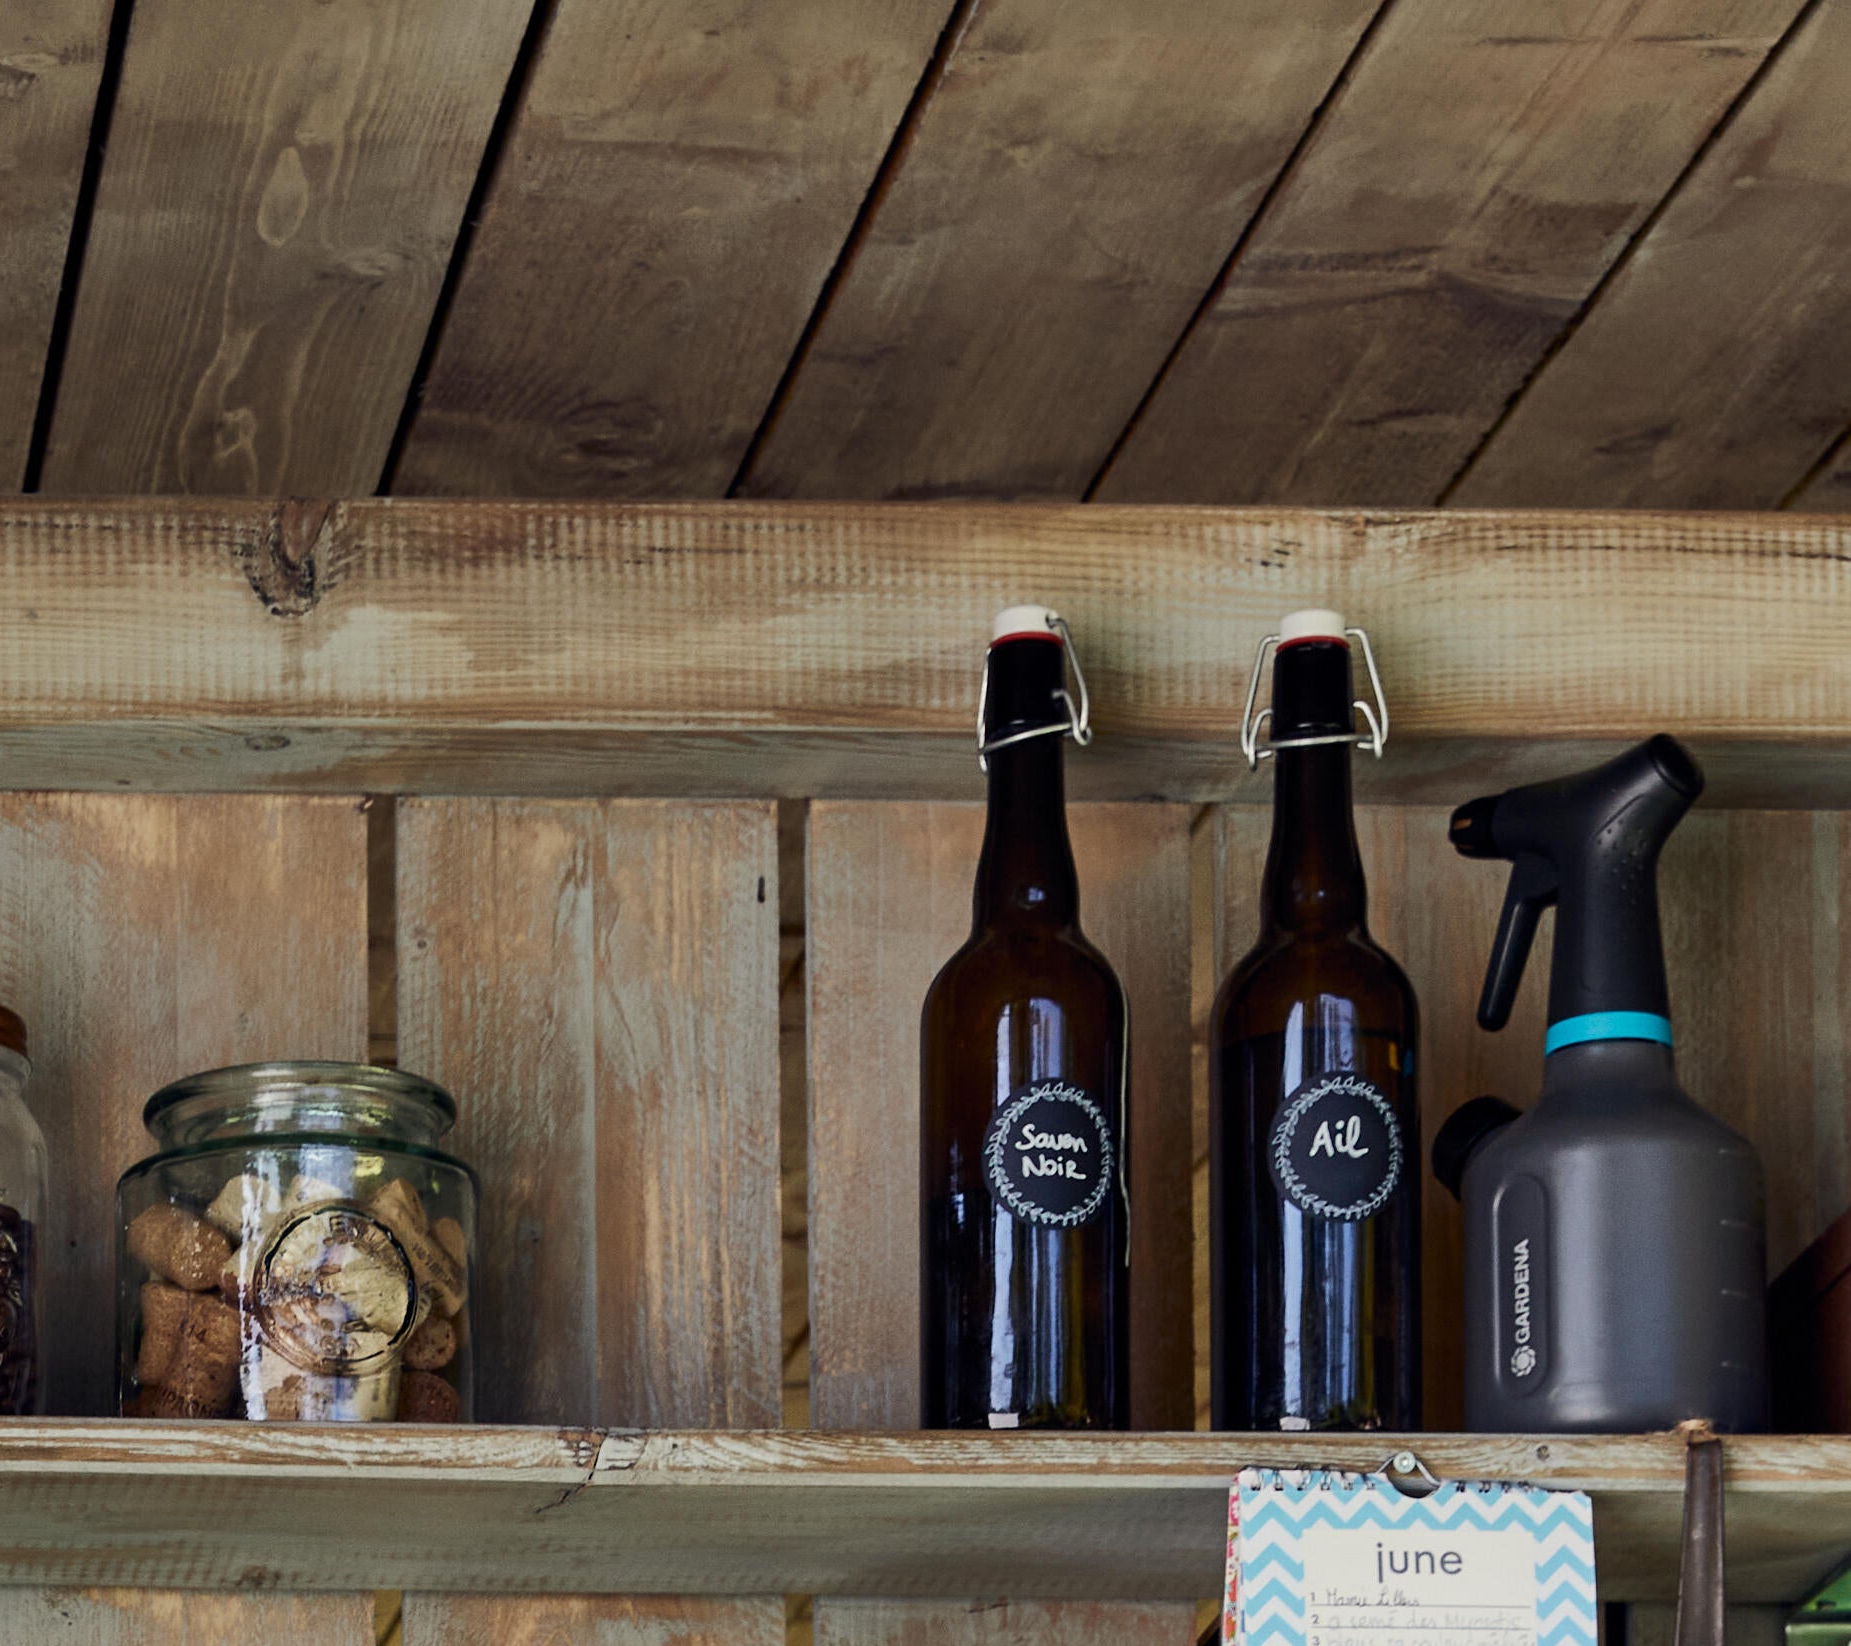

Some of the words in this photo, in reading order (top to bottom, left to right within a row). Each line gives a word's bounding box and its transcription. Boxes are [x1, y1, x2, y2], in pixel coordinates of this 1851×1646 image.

[1015, 1124, 1088, 1153] Savon
[1309, 1114, 1370, 1158] Ail
[1512, 1237, 1531, 1344] GARDENA
[1376, 1542, 1464, 1583] june
[1311, 1614, 1320, 1625] 2
[1312, 1636, 1320, 1646] 3
